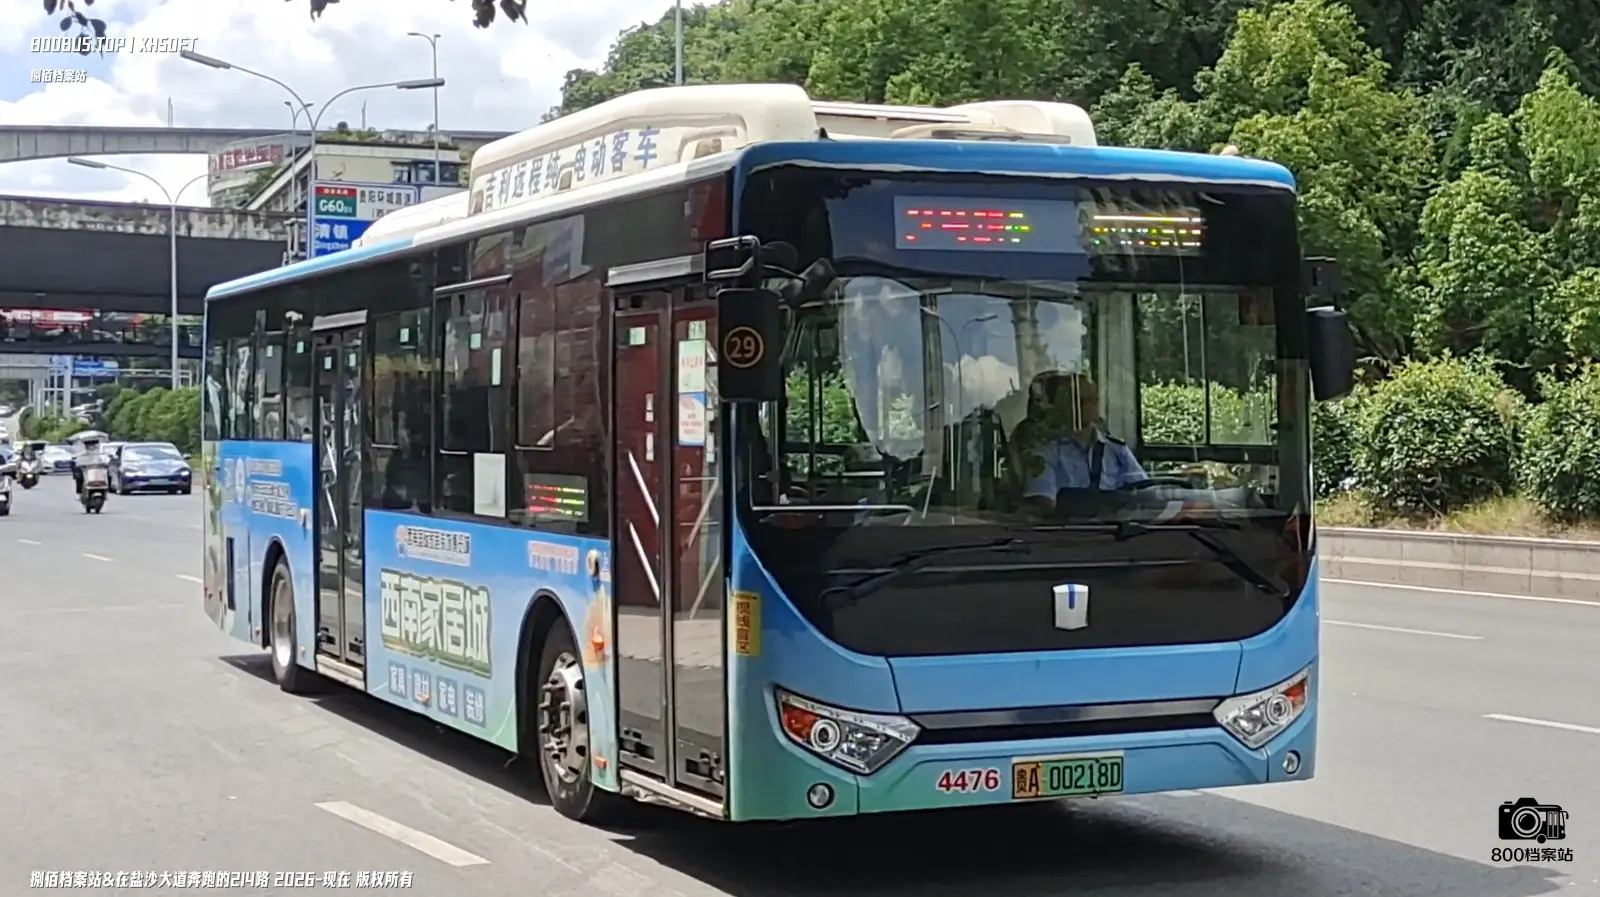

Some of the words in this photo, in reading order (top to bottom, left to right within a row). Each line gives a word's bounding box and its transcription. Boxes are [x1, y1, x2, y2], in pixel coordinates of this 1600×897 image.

[485, 126, 660, 209] 吉利远程纯电动客车
[359, 190, 412, 205] 贵阳环城高速
[314, 223, 349, 240] 清镇
[730, 337, 756, 358] 29
[381, 570, 490, 665] 西南家居城
[390, 665, 406, 696] 家具
[439, 681, 456, 713] 家电
[937, 768, 1000, 792] 4476
[1050, 762, 1121, 790] 00218D
